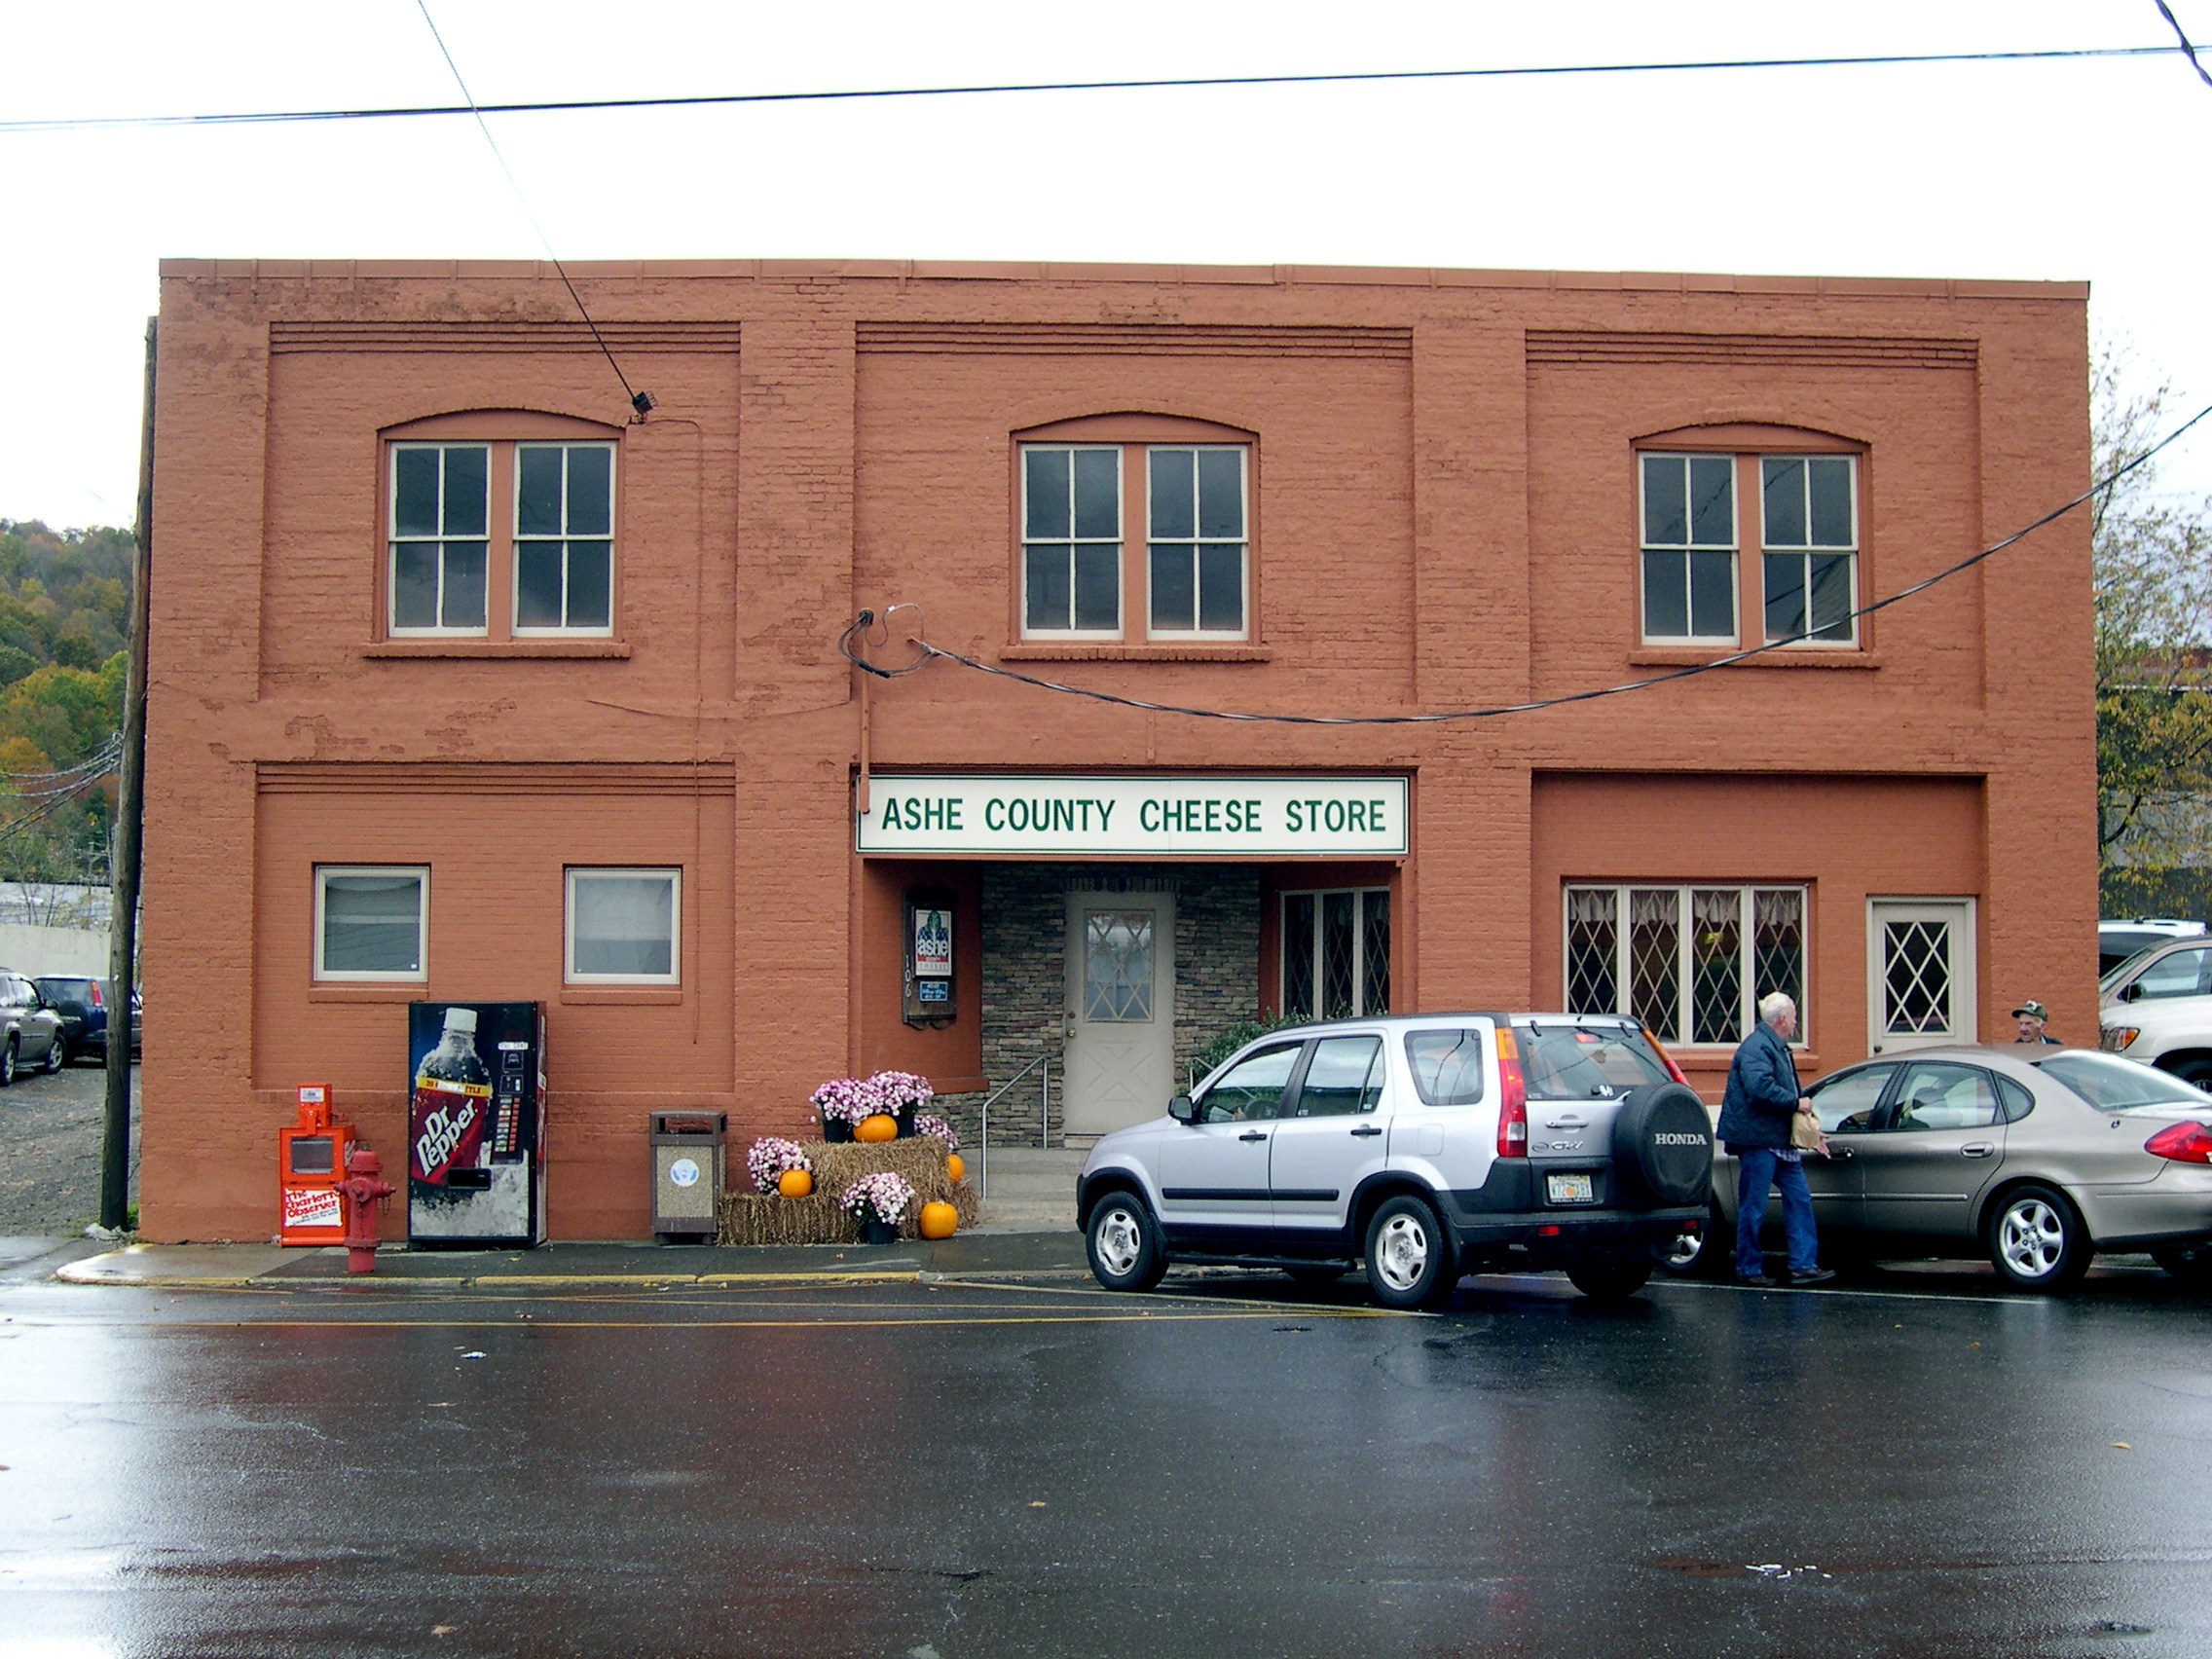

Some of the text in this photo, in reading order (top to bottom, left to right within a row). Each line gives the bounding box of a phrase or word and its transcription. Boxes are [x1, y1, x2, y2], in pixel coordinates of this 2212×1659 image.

[882, 797, 1385, 831] ASHE COUNTY CHEESE STORE
[918, 939, 948, 956] ashe
[424, 1105, 450, 1143] Dr
[417, 1098, 475, 1177] Pepper
[1655, 1133, 1707, 1145] HONDA
[286, 1189, 307, 1201] The
[286, 1191, 340, 1208] Charlott
[288, 1200, 337, 1217] Observer
